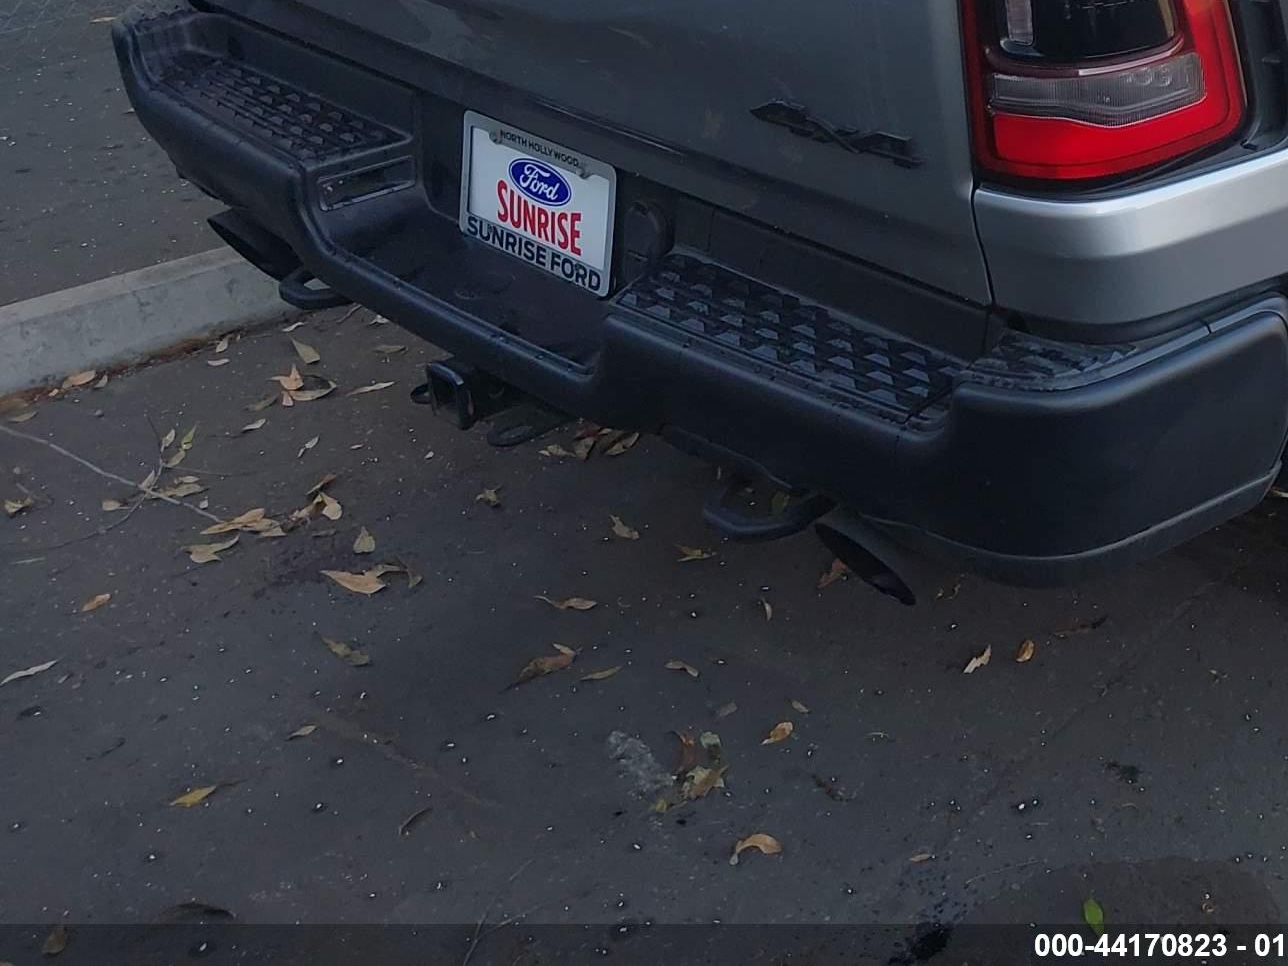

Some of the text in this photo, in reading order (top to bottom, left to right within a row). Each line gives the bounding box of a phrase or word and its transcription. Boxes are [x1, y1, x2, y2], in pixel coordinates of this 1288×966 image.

[499, 129, 527, 147] NORTH
[519, 163, 562, 202] Ford
[497, 179, 582, 257] SUNRISE
[467, 216, 601, 293] SUNRISE FORD
